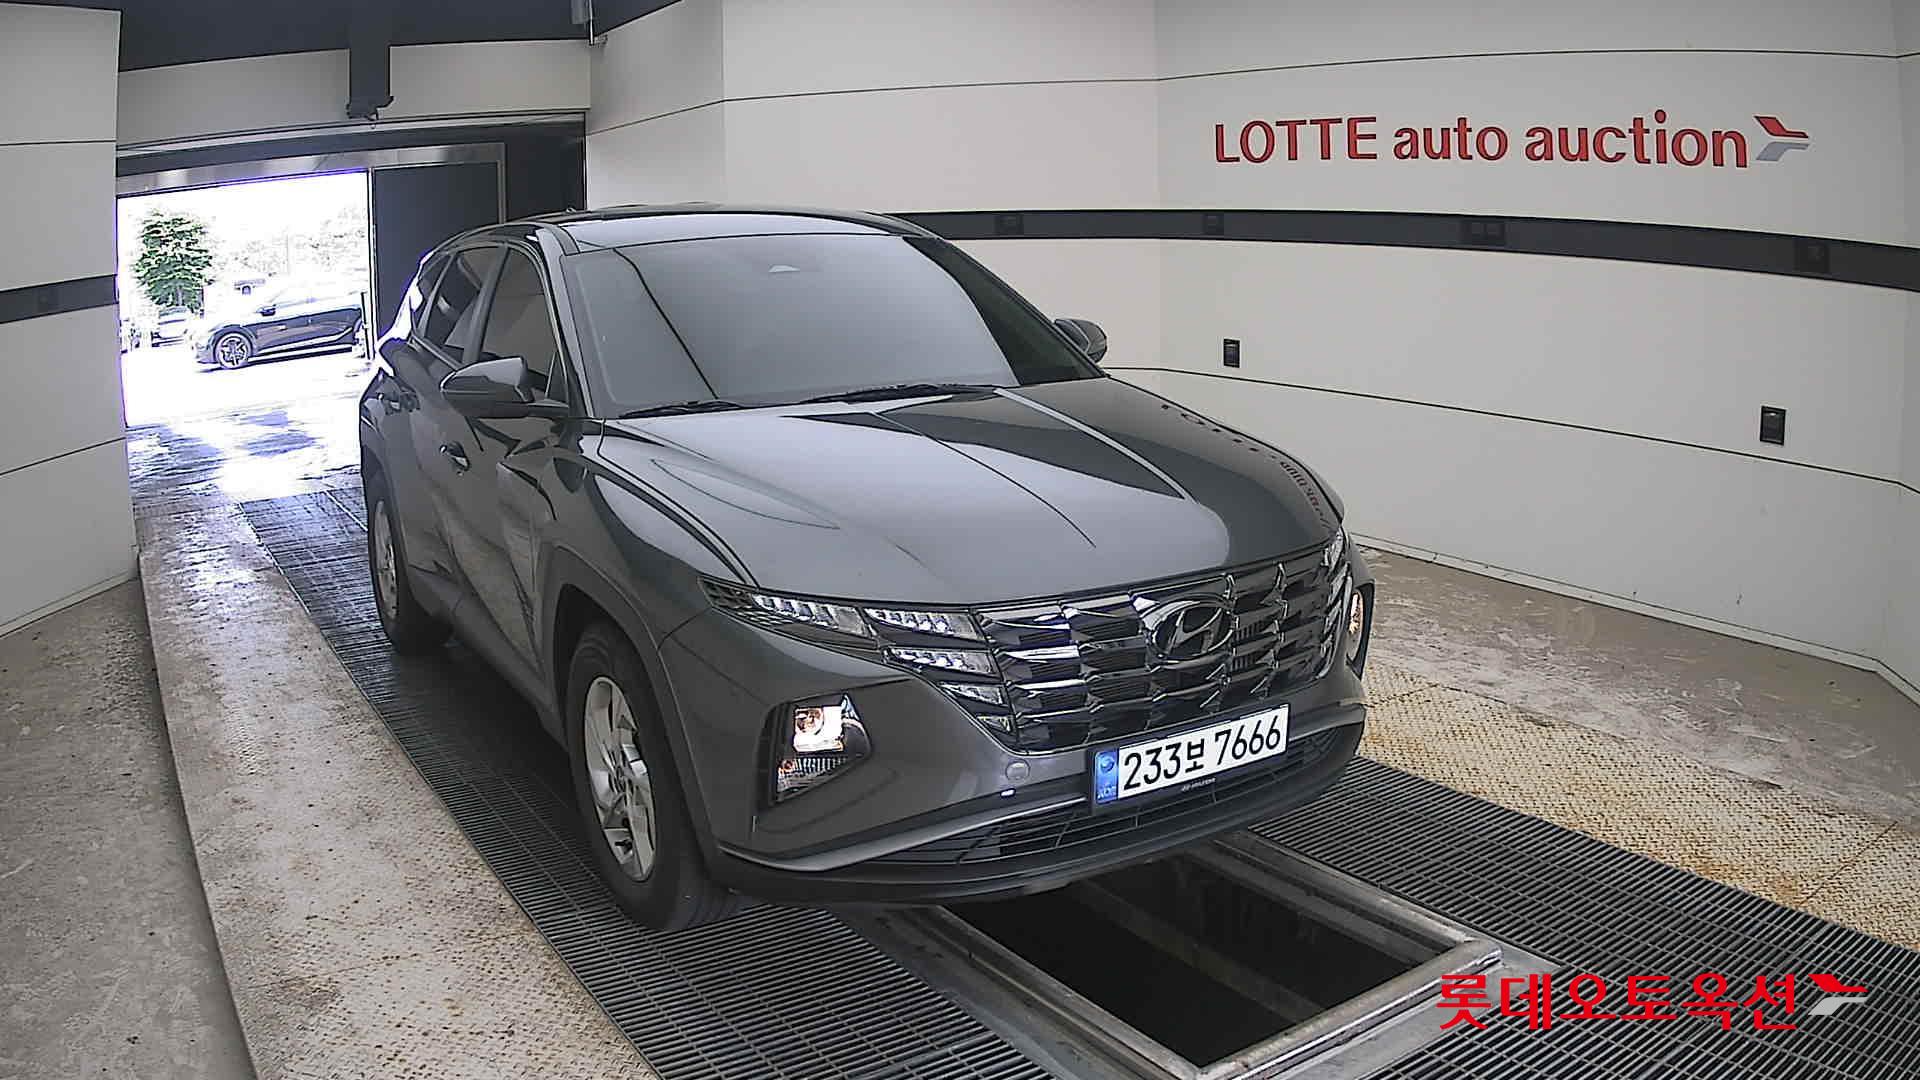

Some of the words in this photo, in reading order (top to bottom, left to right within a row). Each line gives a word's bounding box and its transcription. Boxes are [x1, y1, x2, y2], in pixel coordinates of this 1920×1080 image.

[1215, 116, 1377, 163] LOTTE
[1393, 116, 1509, 161] auto
[1525, 109, 1749, 168] auction
[1123, 738, 1205, 791] 233보
[1214, 715, 1282, 766] 7666
